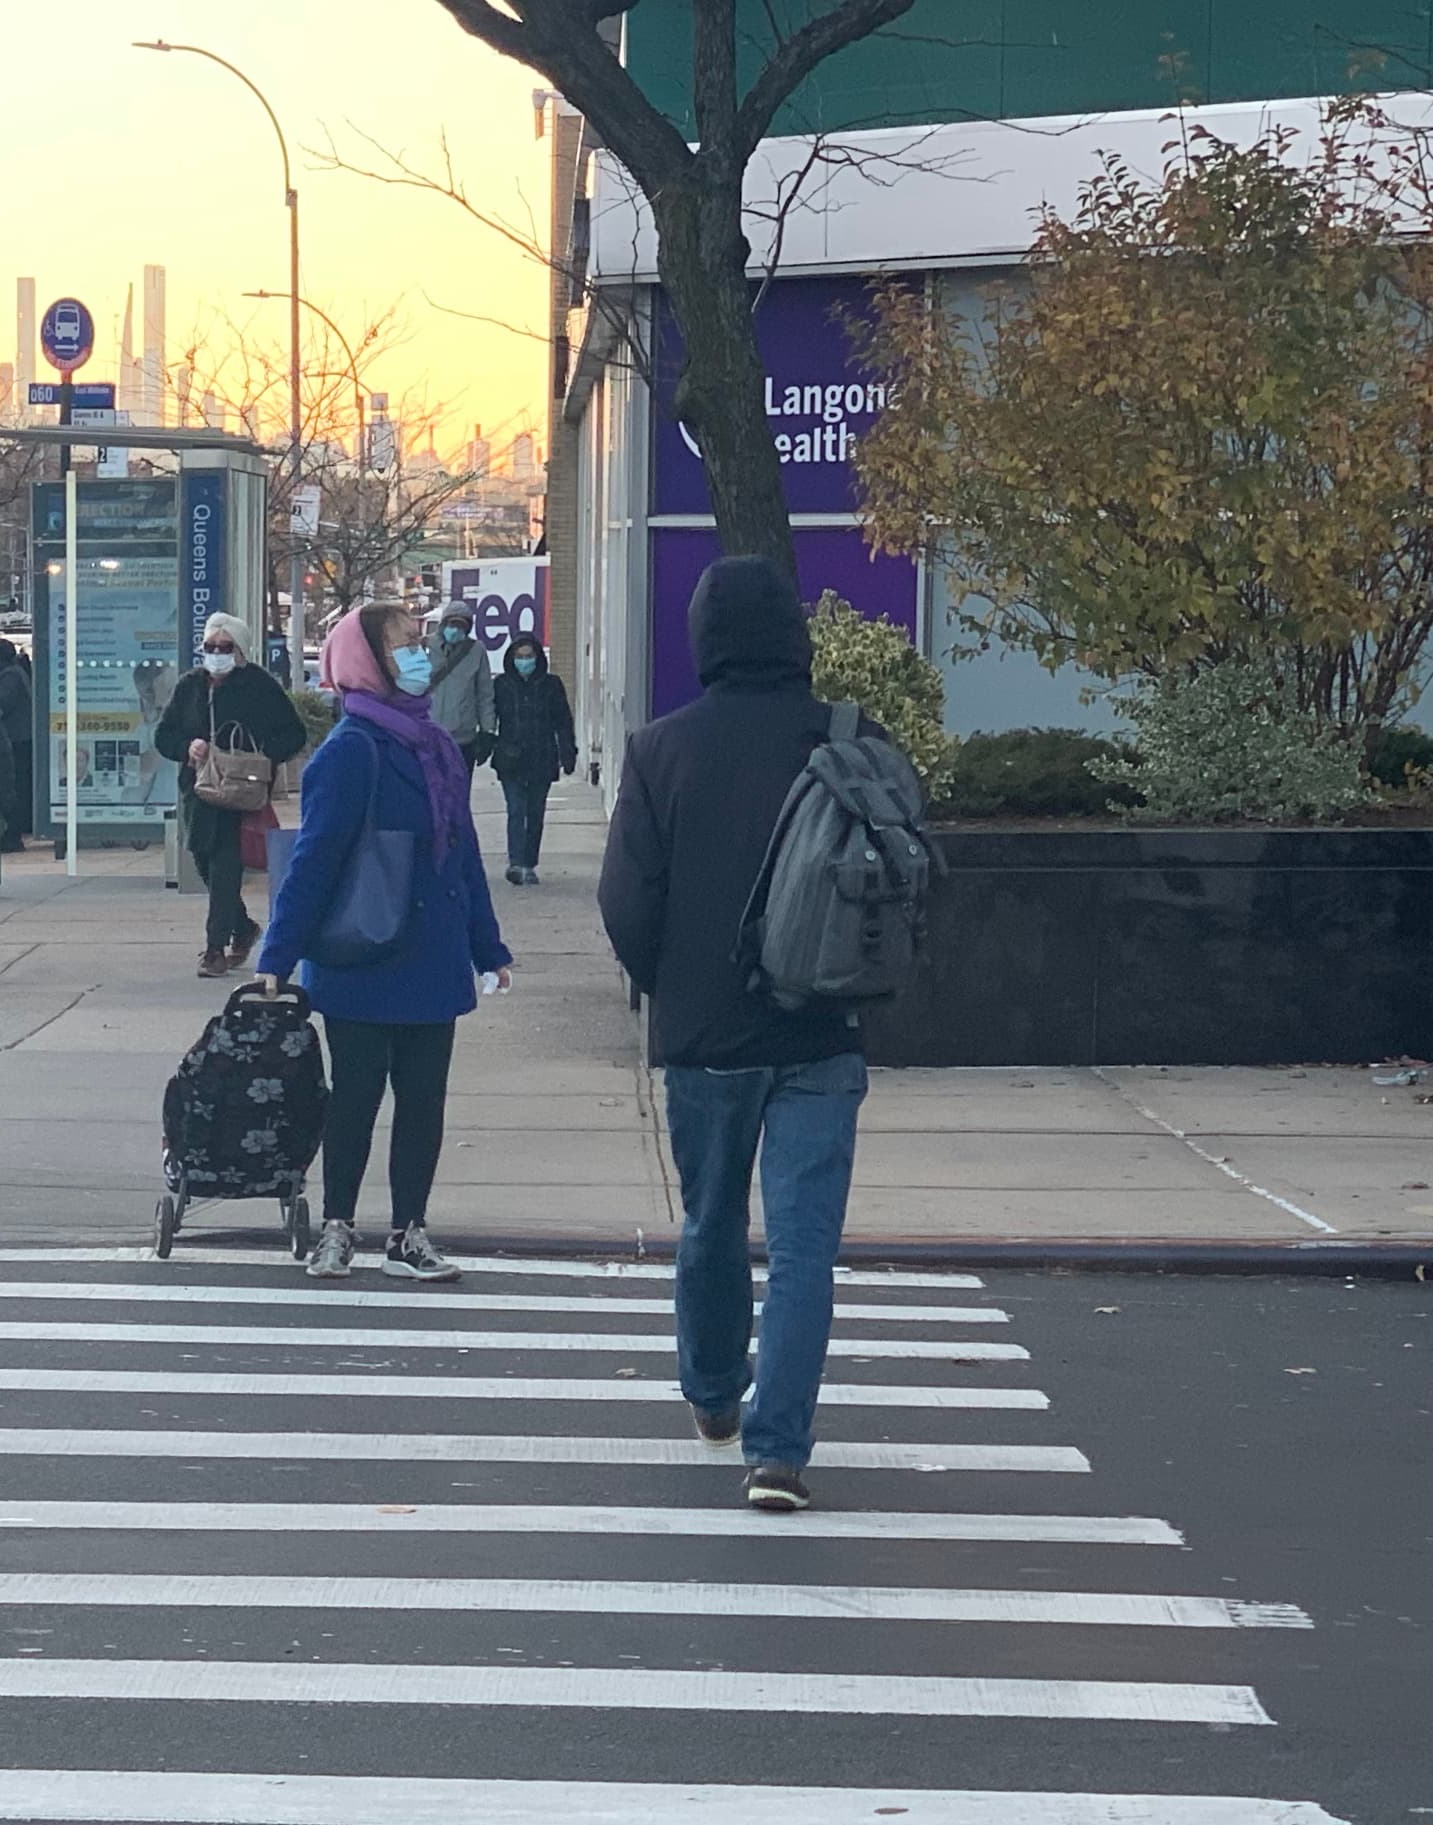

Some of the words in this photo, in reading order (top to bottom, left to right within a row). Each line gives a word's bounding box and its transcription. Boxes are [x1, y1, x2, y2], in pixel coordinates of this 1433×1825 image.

[774, 422, 857, 464] ealth
[193, 504, 211, 582] Queens
[193, 588, 211, 668] Bouleva
[450, 566, 552, 652] Fed
[272, 648, 281, 662] P
